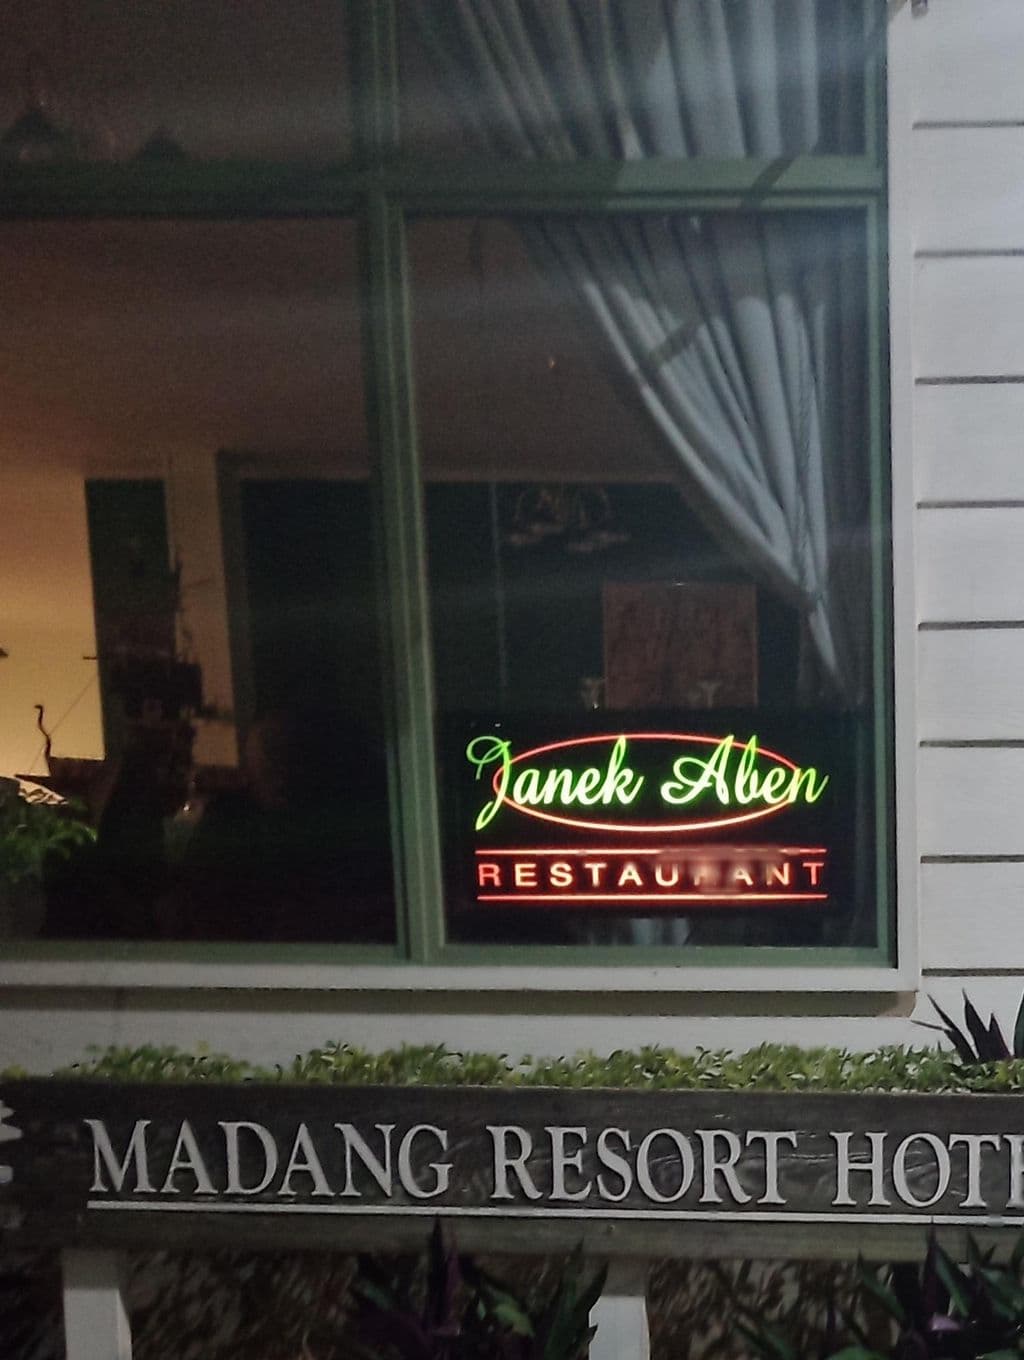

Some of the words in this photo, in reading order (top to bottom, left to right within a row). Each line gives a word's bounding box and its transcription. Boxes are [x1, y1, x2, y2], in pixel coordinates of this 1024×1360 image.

[466, 735, 645, 831] Janek
[660, 734, 829, 805] Aben
[83, 1118, 453, 1199] MADANG
[486, 1125, 798, 1205] RESORT
